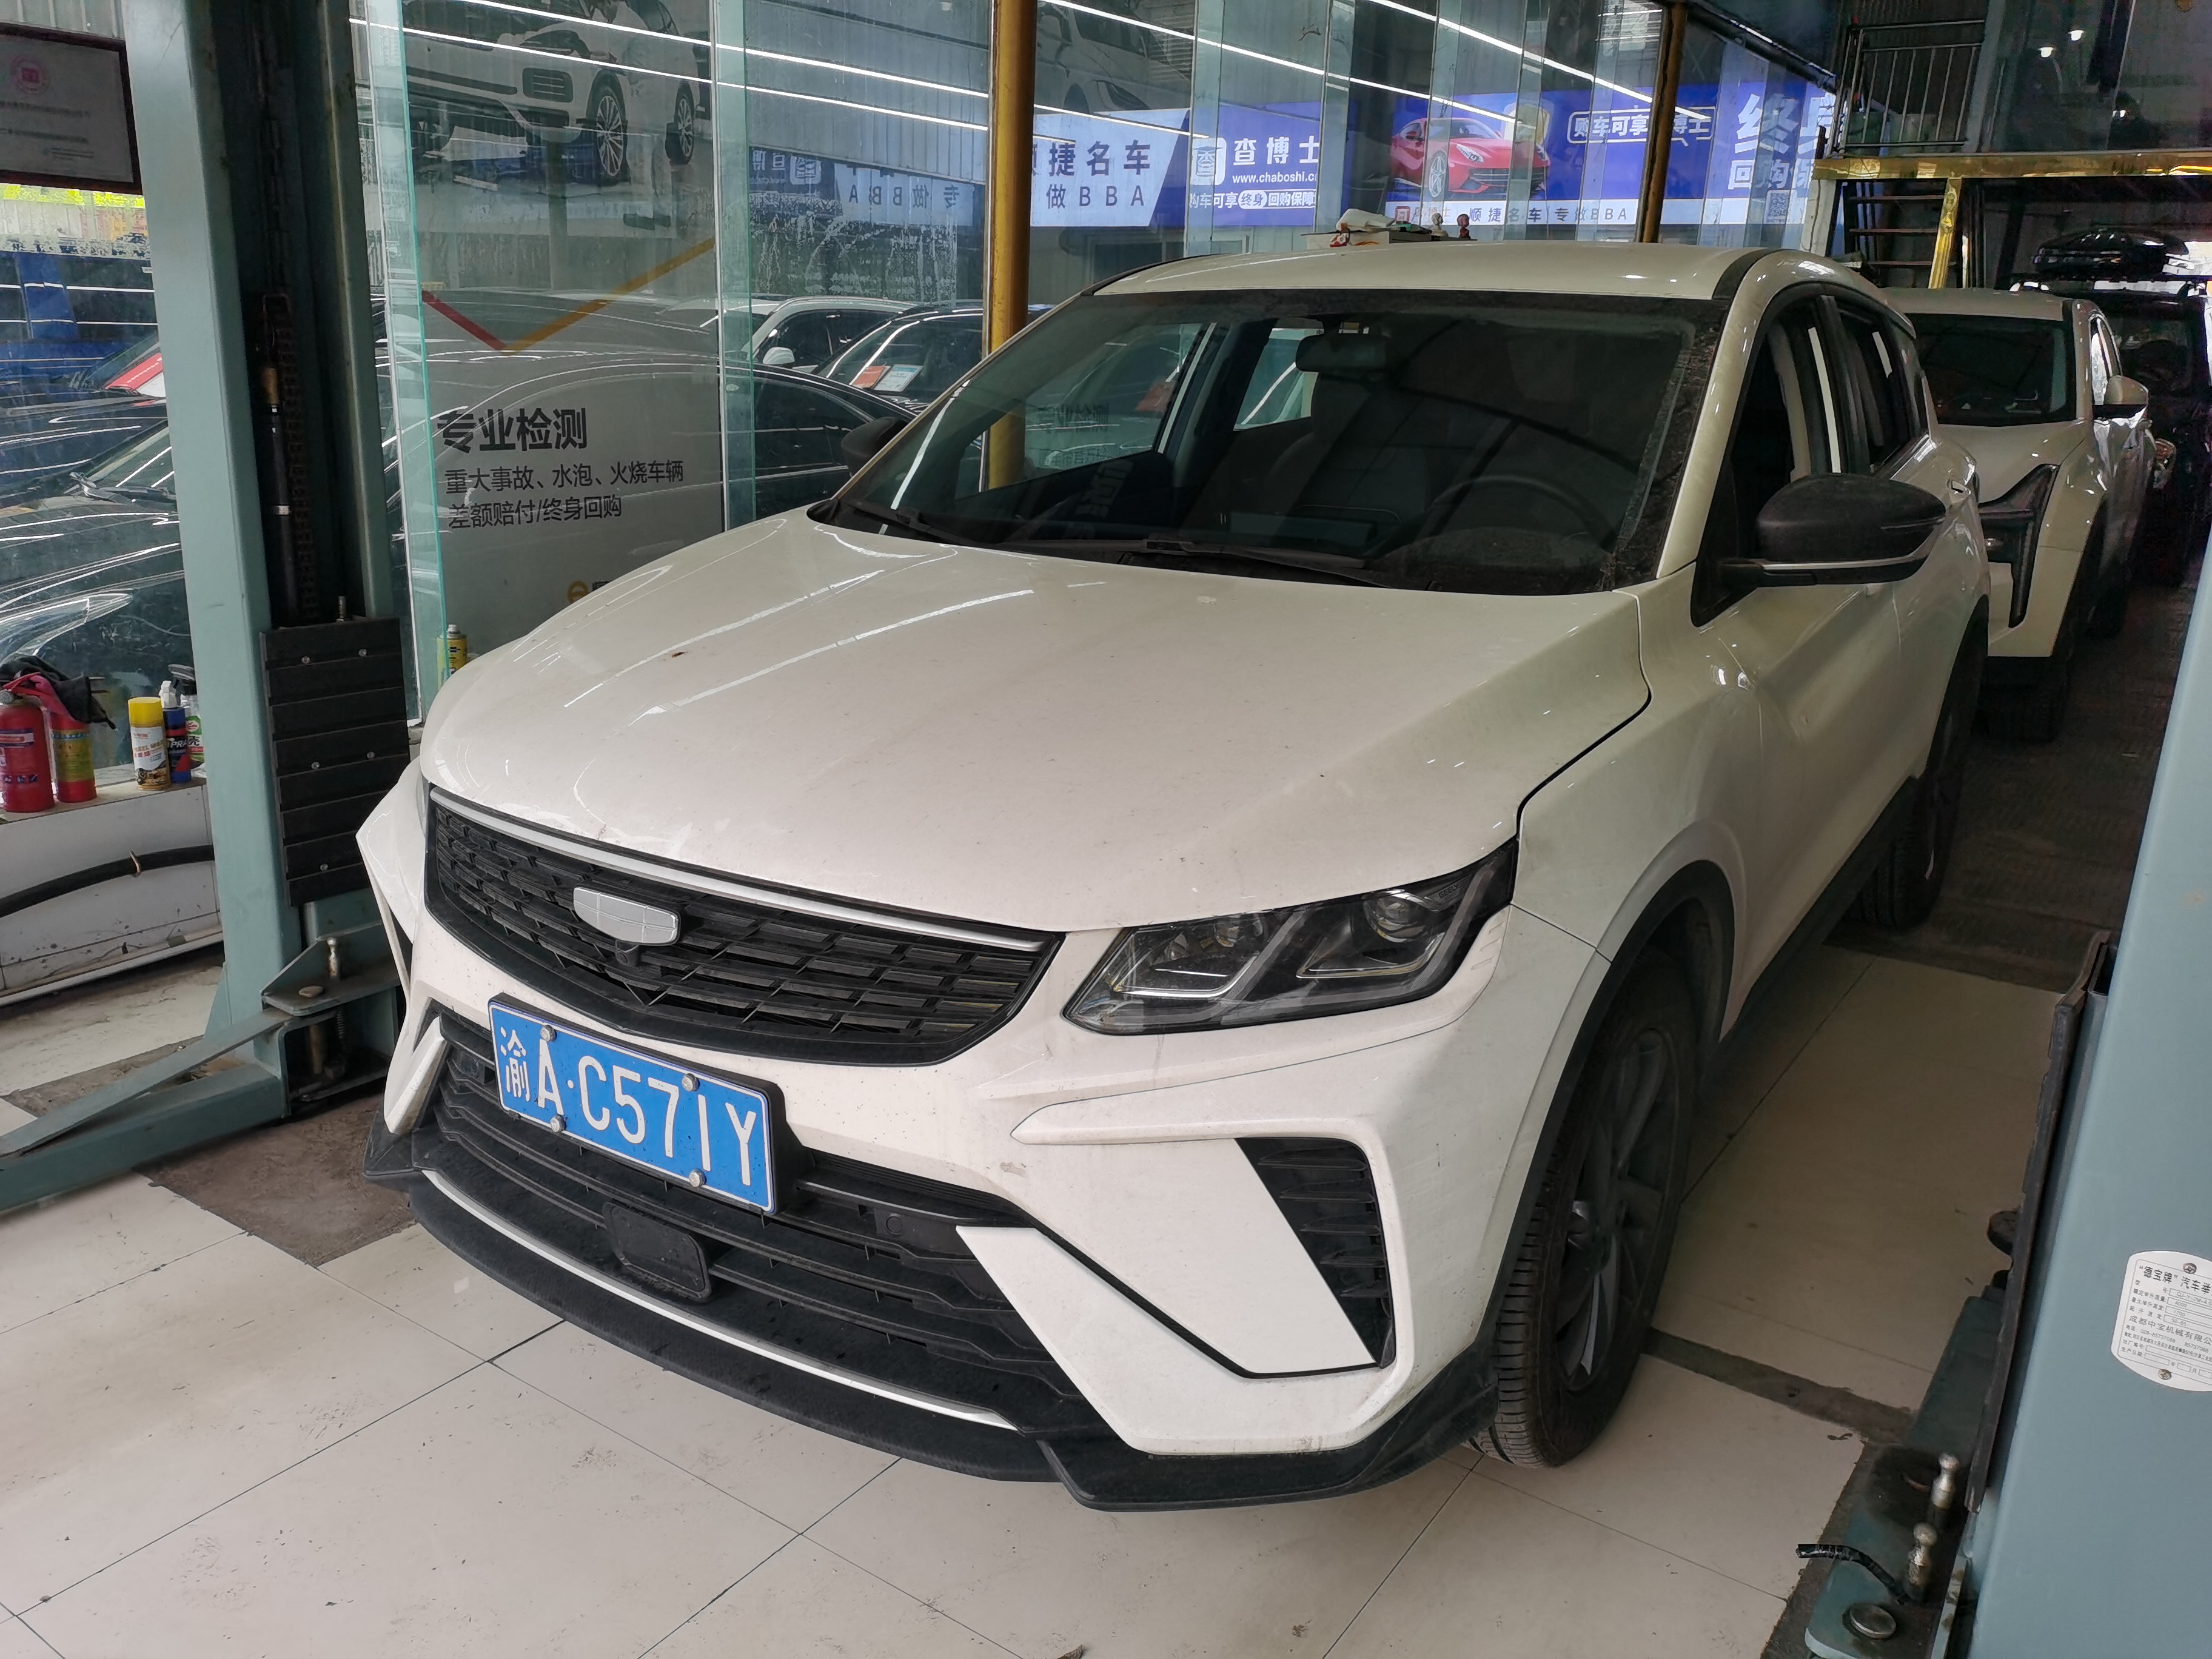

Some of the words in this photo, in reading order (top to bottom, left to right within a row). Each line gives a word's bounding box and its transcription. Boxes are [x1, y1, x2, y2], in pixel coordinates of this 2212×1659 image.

[1033, 139, 1151, 176] 捷名车
[1233, 135, 1319, 166] 查博士
[1189, 191, 1316, 209] 购车可享终身回购保障
[437, 407, 588, 454] 专业检测
[444, 459, 684, 495] 重大事故、水泡、火烧车辆
[1438, 883, 1459, 899] GEELY
[500, 1026, 757, 1187] 渝A·C571Y
[2180, 1276, 2212, 1295] 汽车举
